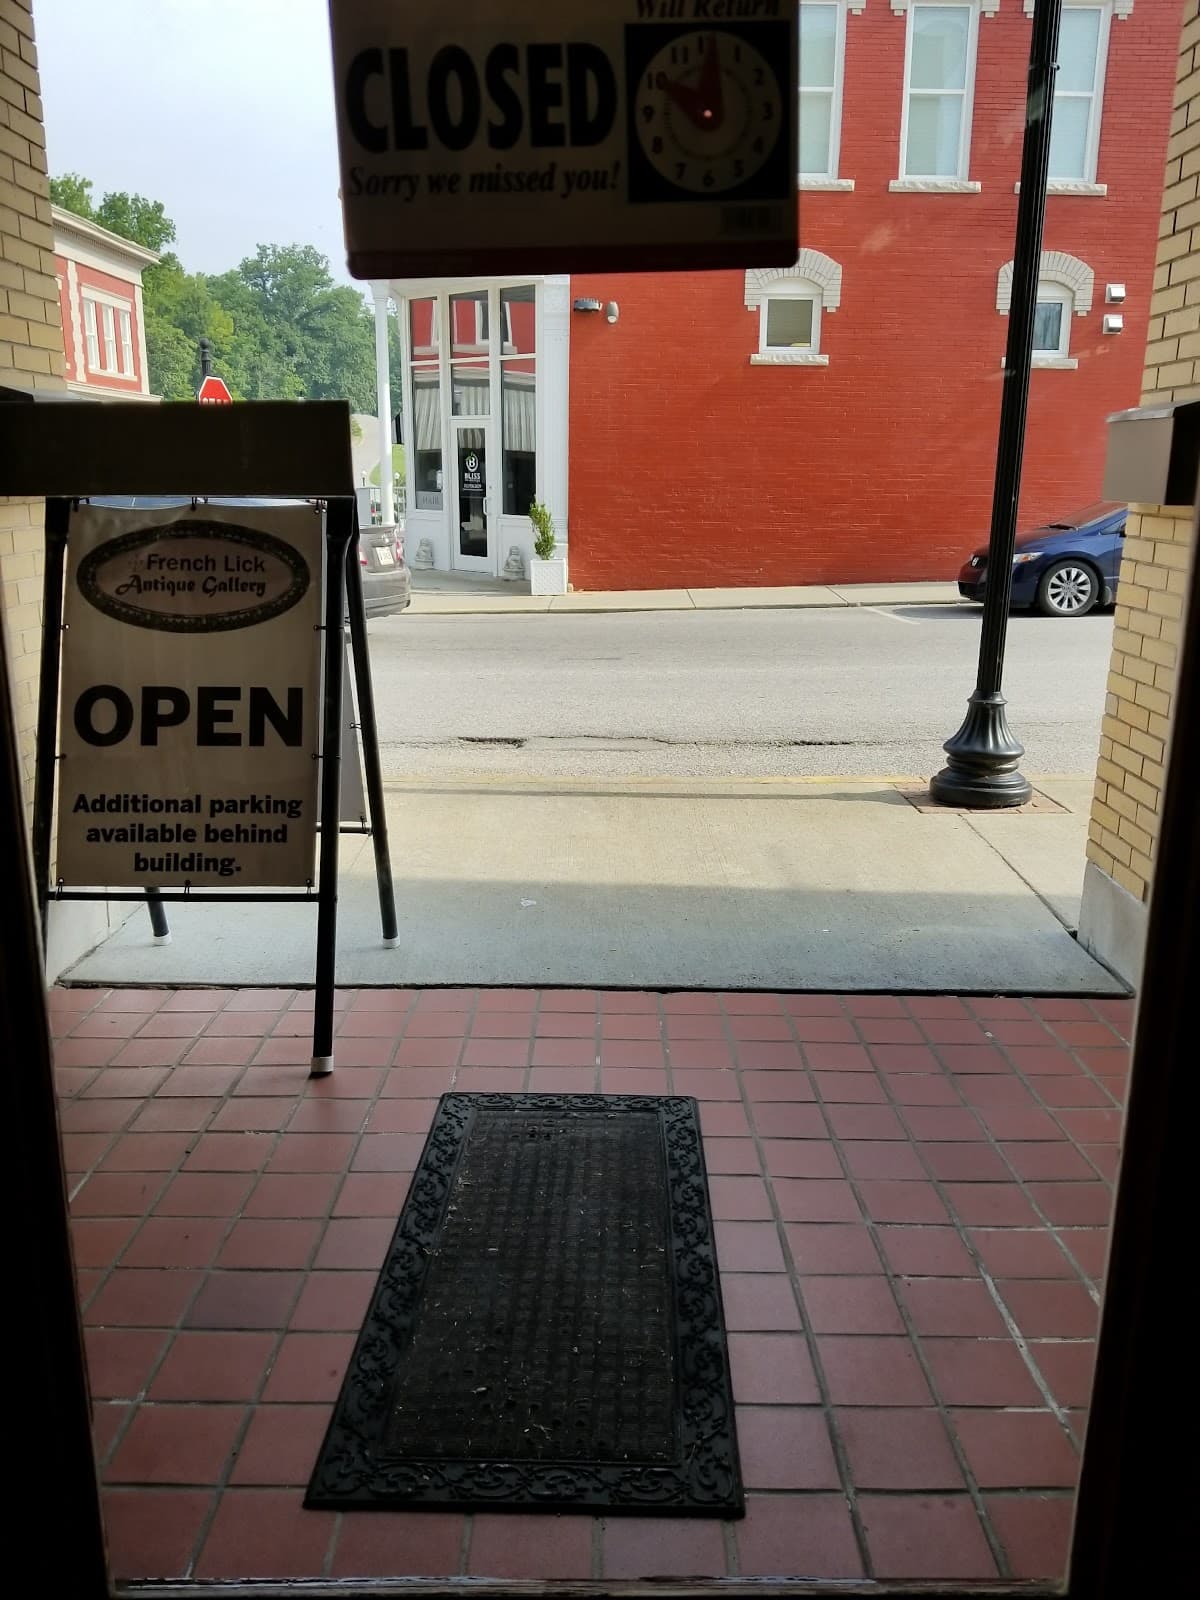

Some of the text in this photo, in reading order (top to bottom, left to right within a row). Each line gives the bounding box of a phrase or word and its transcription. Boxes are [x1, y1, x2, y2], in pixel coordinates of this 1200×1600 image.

[671, 46, 688, 64] 11
[734, 45, 741, 63] 1
[647, 72, 668, 90] 10
[753, 68, 763, 86] 2
[345, 42, 618, 153] CLOSED
[643, 105, 654, 123] 9
[762, 101, 772, 120] 3
[652, 136, 663, 154] 8
[753, 136, 763, 154] 4
[675, 163, 686, 180] 7
[734, 159, 744, 177] 5
[349, 162, 620, 202] Sorry we missed you!
[703, 169, 714, 187] 6
[464, 472, 480, 480] BLISS
[147, 554, 266, 572] French Lick
[115, 574, 266, 597] Antique Gallery
[73, 684, 304, 748] OPEN
[73, 793, 303, 819] Additional parking
[86, 823, 288, 844] available behind
[133, 852, 242, 877] building.
